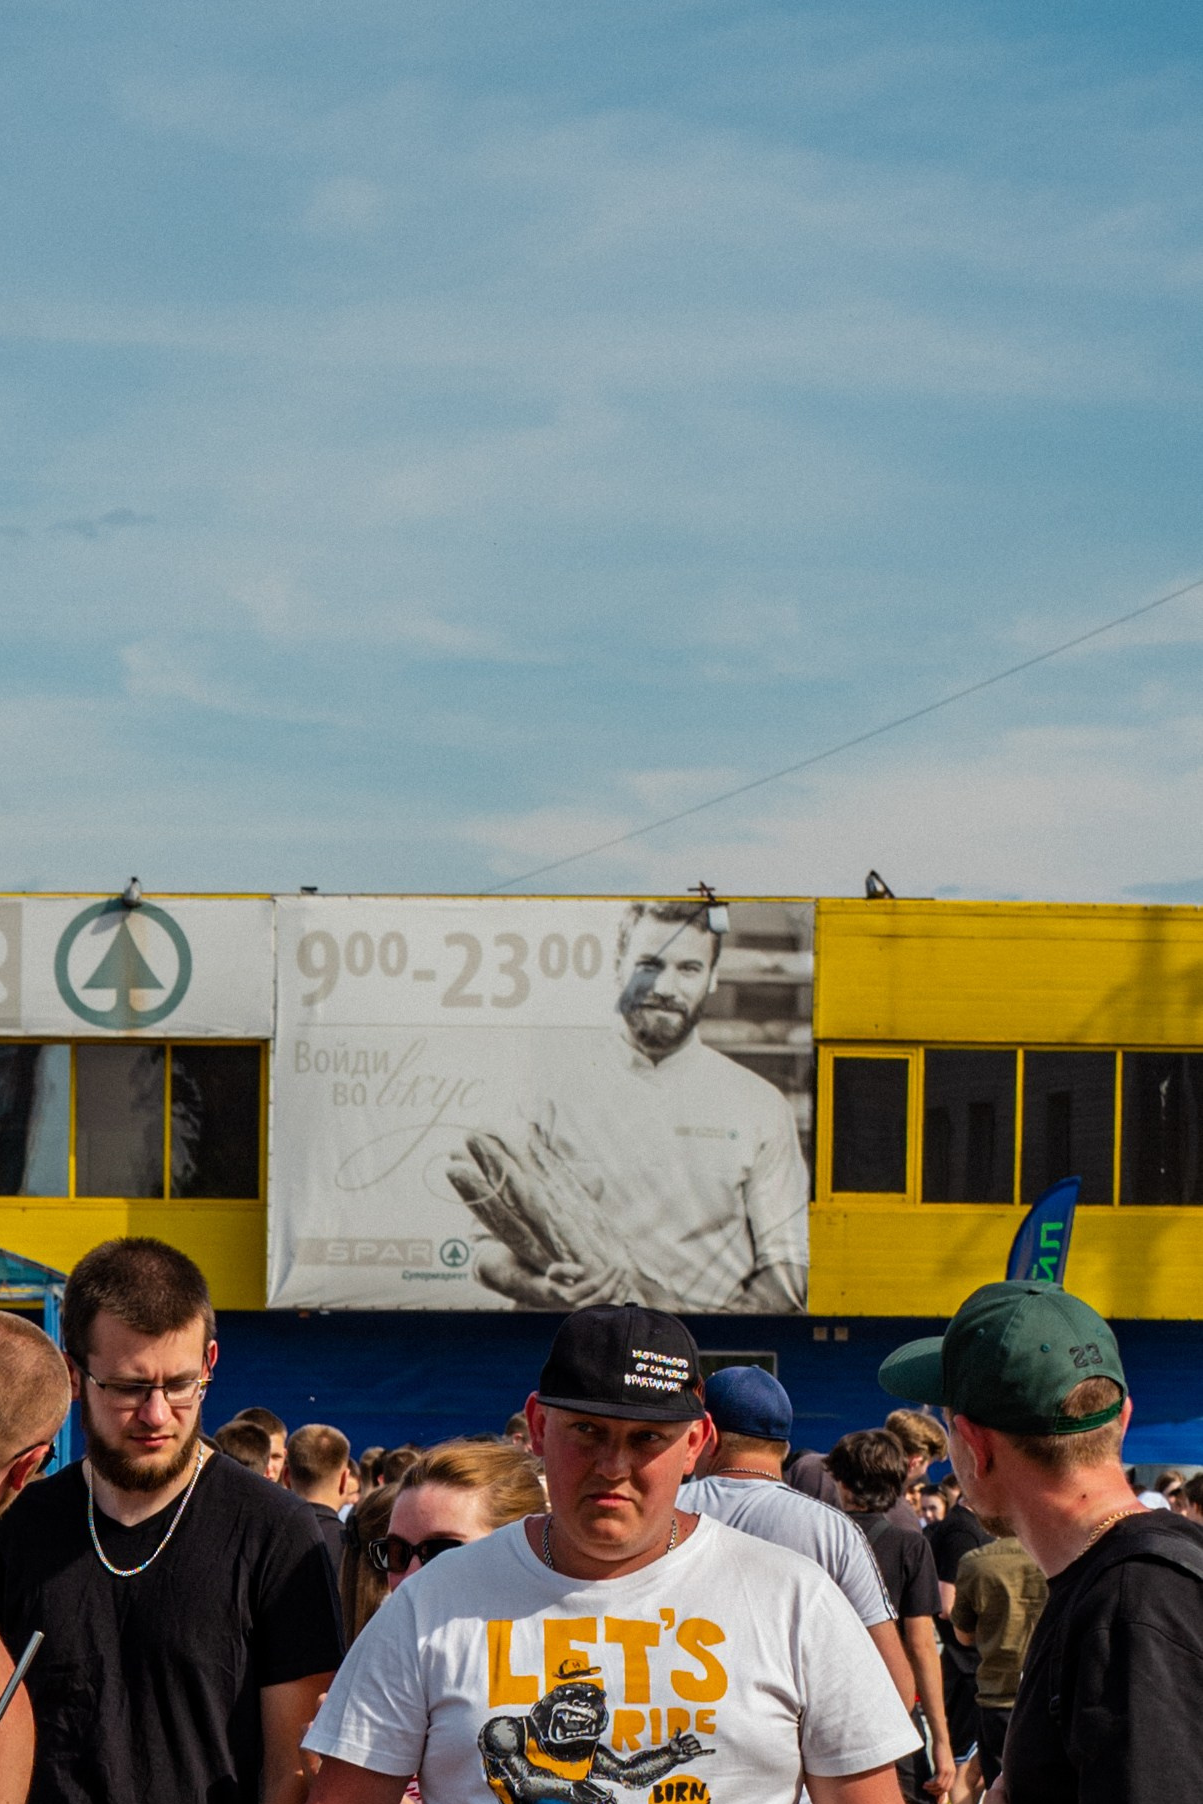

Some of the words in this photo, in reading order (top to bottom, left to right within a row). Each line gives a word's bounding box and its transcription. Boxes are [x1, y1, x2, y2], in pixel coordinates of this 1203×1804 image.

[295, 1040, 390, 1079] Войди
[333, 1082, 367, 1106] во
[325, 1241, 434, 1263] SPAR
[1069, 1342, 1104, 1369] 23
[486, 1607, 729, 1708] LET'S
[611, 1707, 717, 1752] RIDE
[653, 1782, 707, 1804] BORN
